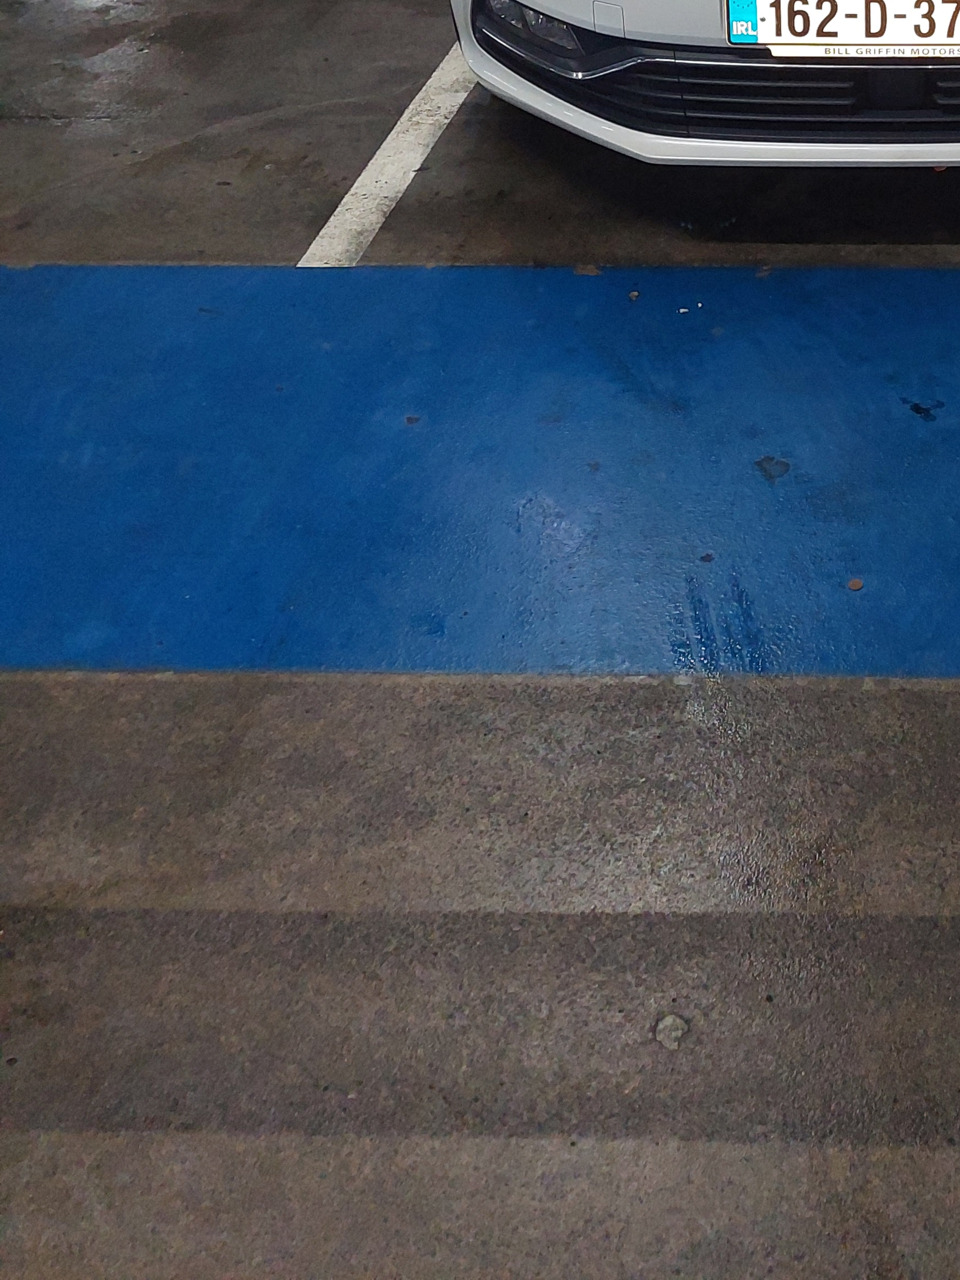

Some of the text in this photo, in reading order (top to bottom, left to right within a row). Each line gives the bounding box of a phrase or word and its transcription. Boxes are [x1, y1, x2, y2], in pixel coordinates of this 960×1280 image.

[732, 20, 758, 36] IRL
[824, 47, 851, 55] BILL
[855, 48, 906, 56] GRIFFIN
